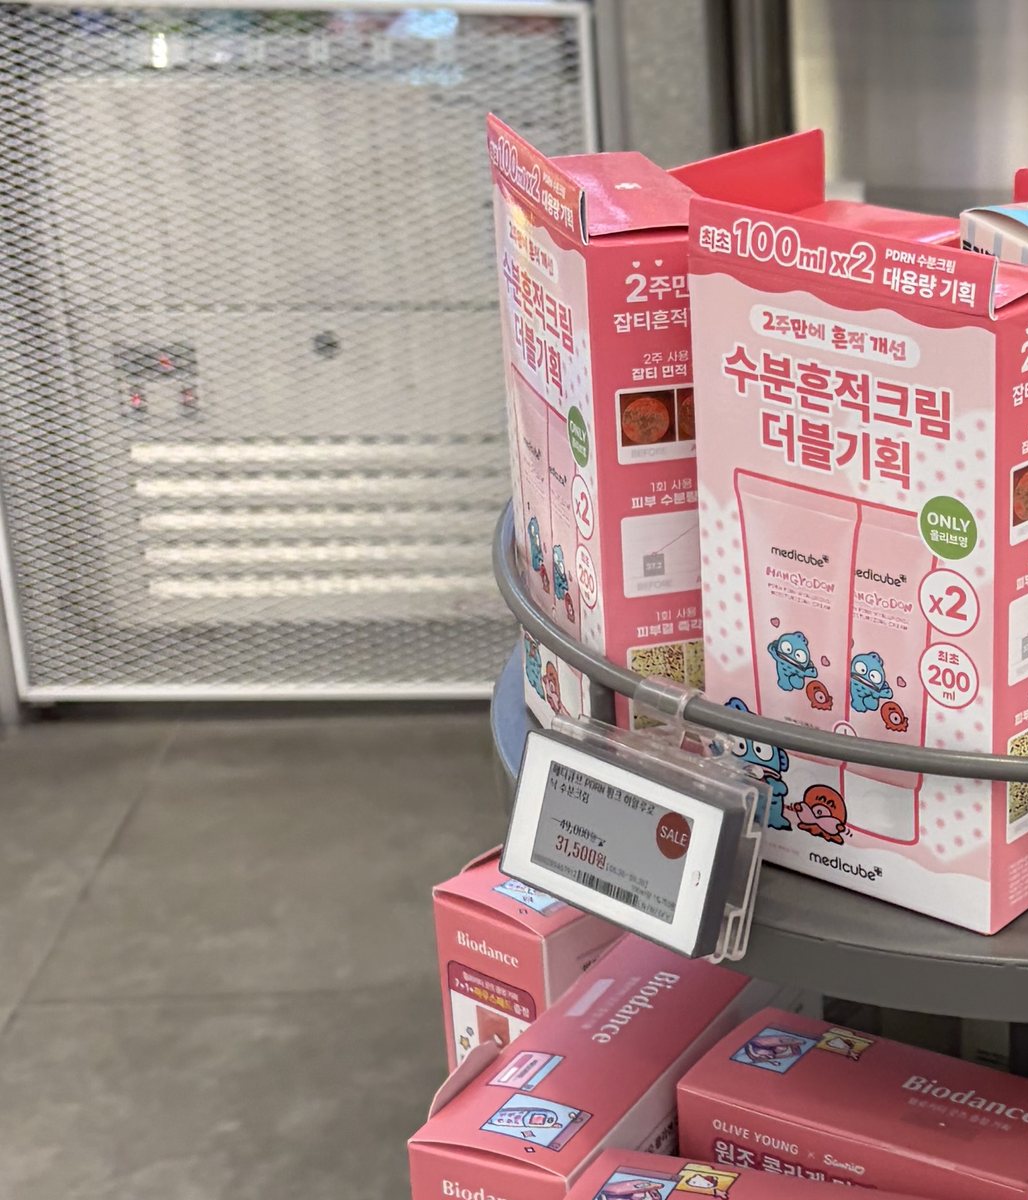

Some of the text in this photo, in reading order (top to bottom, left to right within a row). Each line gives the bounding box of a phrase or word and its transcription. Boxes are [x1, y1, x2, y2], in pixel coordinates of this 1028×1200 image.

[700, 219, 876, 283] 최초 100ml x2
[885, 249, 956, 274] PDRN 수분크림
[503, 252, 574, 354] 수분흔적크림
[625, 273, 690, 303] 2주만
[883, 268, 976, 307] 대용량 기획
[762, 311, 906, 360] 2주만에 흔적 개선
[514, 316, 563, 396] 더블기획
[632, 368, 657, 380] 잡티
[724, 346, 951, 440] 수분흔적크림
[762, 411, 910, 490] 더블기획
[927, 511, 971, 534] ONLY
[771, 545, 825, 568] medicube
[765, 566, 834, 593] HANGYODON
[853, 568, 902, 588] edicube
[929, 587, 968, 621] x2
[938, 650, 960, 664] 최초
[928, 664, 970, 693] 200
[942, 689, 956, 701] ml
[555, 835, 607, 870] 31,500원
[660, 826, 688, 847] SALE
[809, 849, 874, 881] medicube
[457, 930, 519, 968] Biodance
[593, 971, 680, 1042] Biodance
[713, 1118, 748, 1141] OLIVE
[753, 1127, 798, 1155] YOUNG
[714, 1141, 757, 1170] 원조
